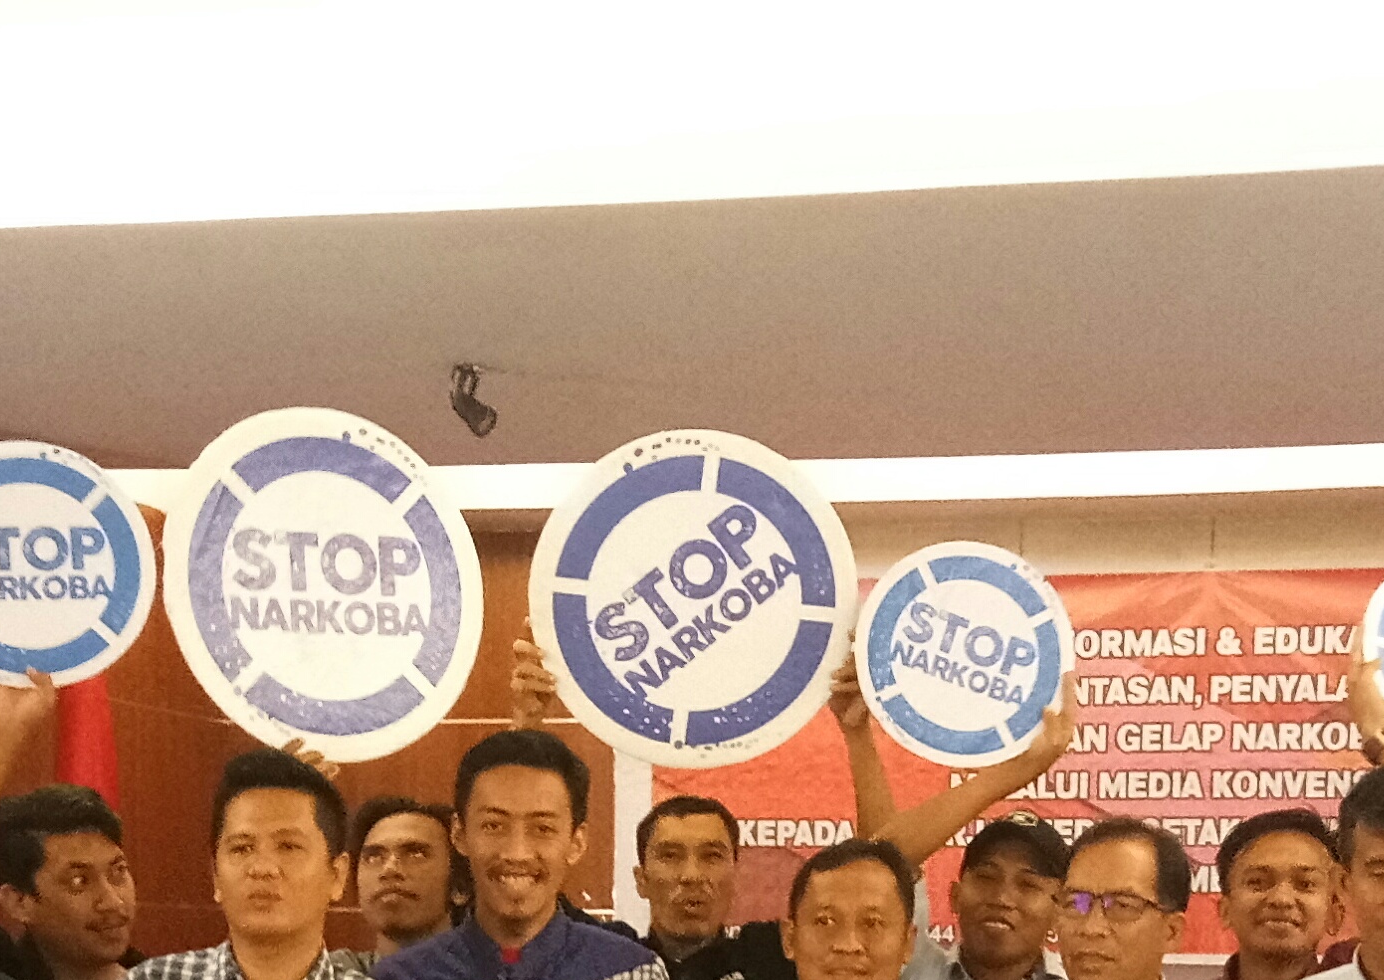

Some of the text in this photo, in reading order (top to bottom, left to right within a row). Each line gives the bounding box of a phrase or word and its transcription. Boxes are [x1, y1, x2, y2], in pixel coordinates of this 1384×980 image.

[231, 529, 422, 596] STOP
[596, 506, 758, 661] STOP
[230, 596, 429, 636] NARKOBA
[624, 554, 801, 699] NARKOBA
[902, 604, 1035, 668] STOP
[1074, 627, 1207, 657] ORMASI
[1216, 626, 1242, 655] &
[891, 642, 1024, 703] NARKOBA
[1075, 676, 1203, 708] NTASAN,
[1117, 724, 1224, 751] GELAP
[1100, 770, 1202, 798] MEDIA
[736, 819, 853, 847] KEPADA
